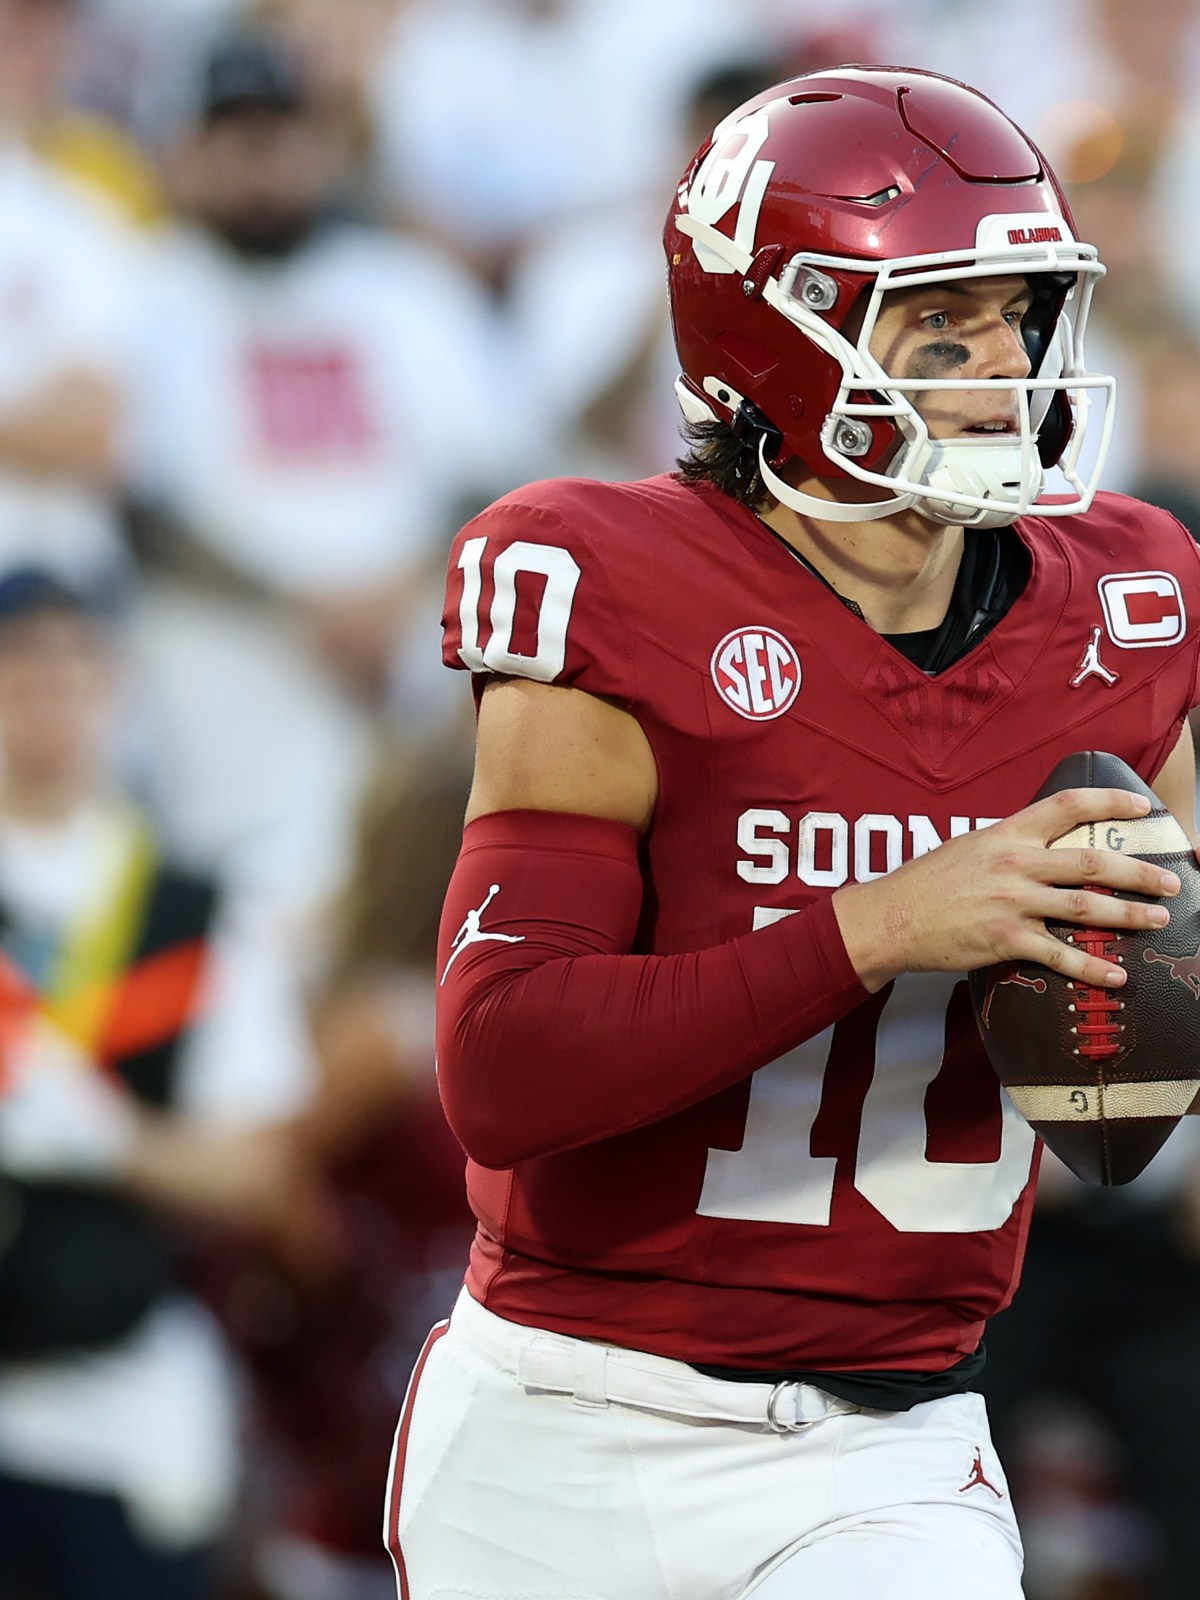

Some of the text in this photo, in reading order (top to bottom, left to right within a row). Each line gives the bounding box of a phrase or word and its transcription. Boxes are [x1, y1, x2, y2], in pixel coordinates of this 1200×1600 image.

[1007, 227, 1062, 244] OKLAHOMA
[455, 535, 582, 682] 10
[1103, 577, 1179, 641] C
[718, 633, 794, 713] SEC
[1106, 827, 1125, 850] G
[696, 906, 1036, 1233] 10
